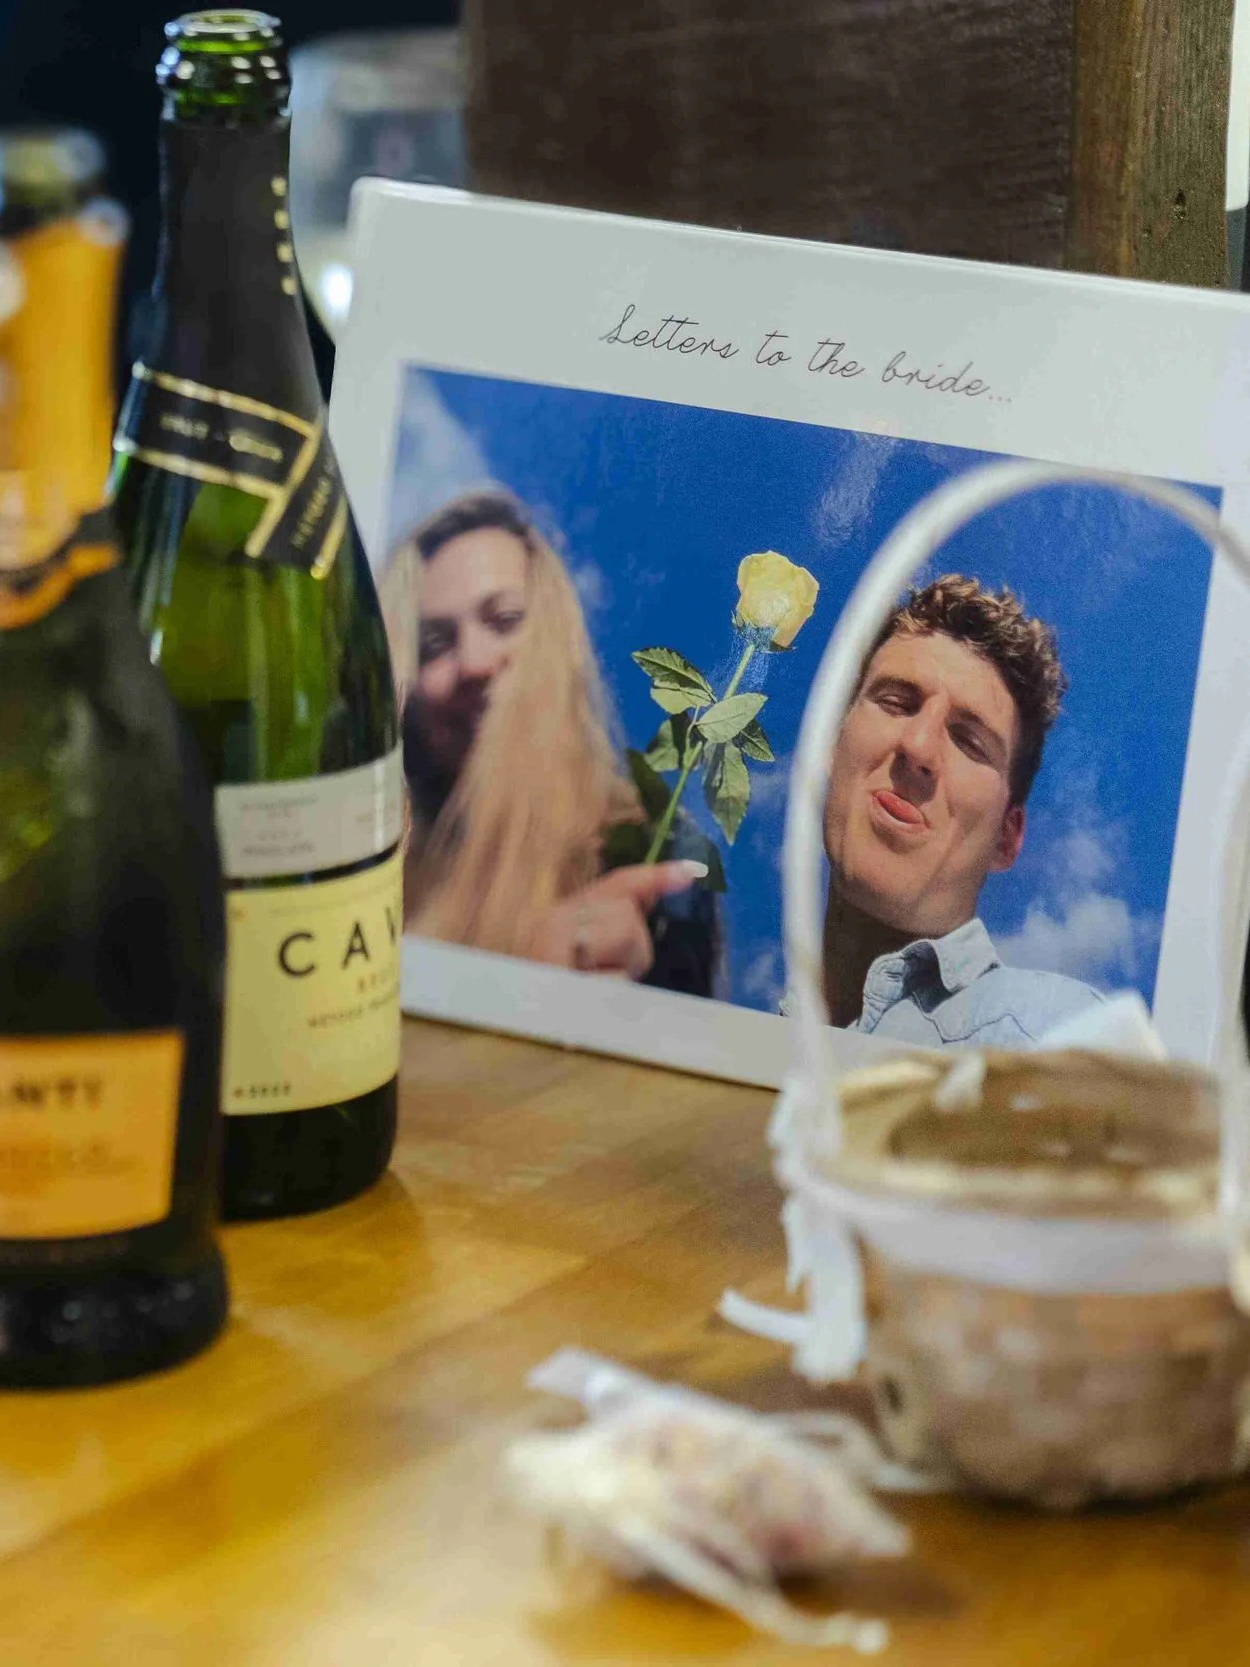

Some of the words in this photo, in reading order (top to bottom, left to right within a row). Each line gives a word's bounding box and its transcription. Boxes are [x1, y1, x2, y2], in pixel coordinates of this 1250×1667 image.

[599, 304, 739, 359] Letters
[755, 330, 791, 366] to
[807, 337, 866, 379] the
